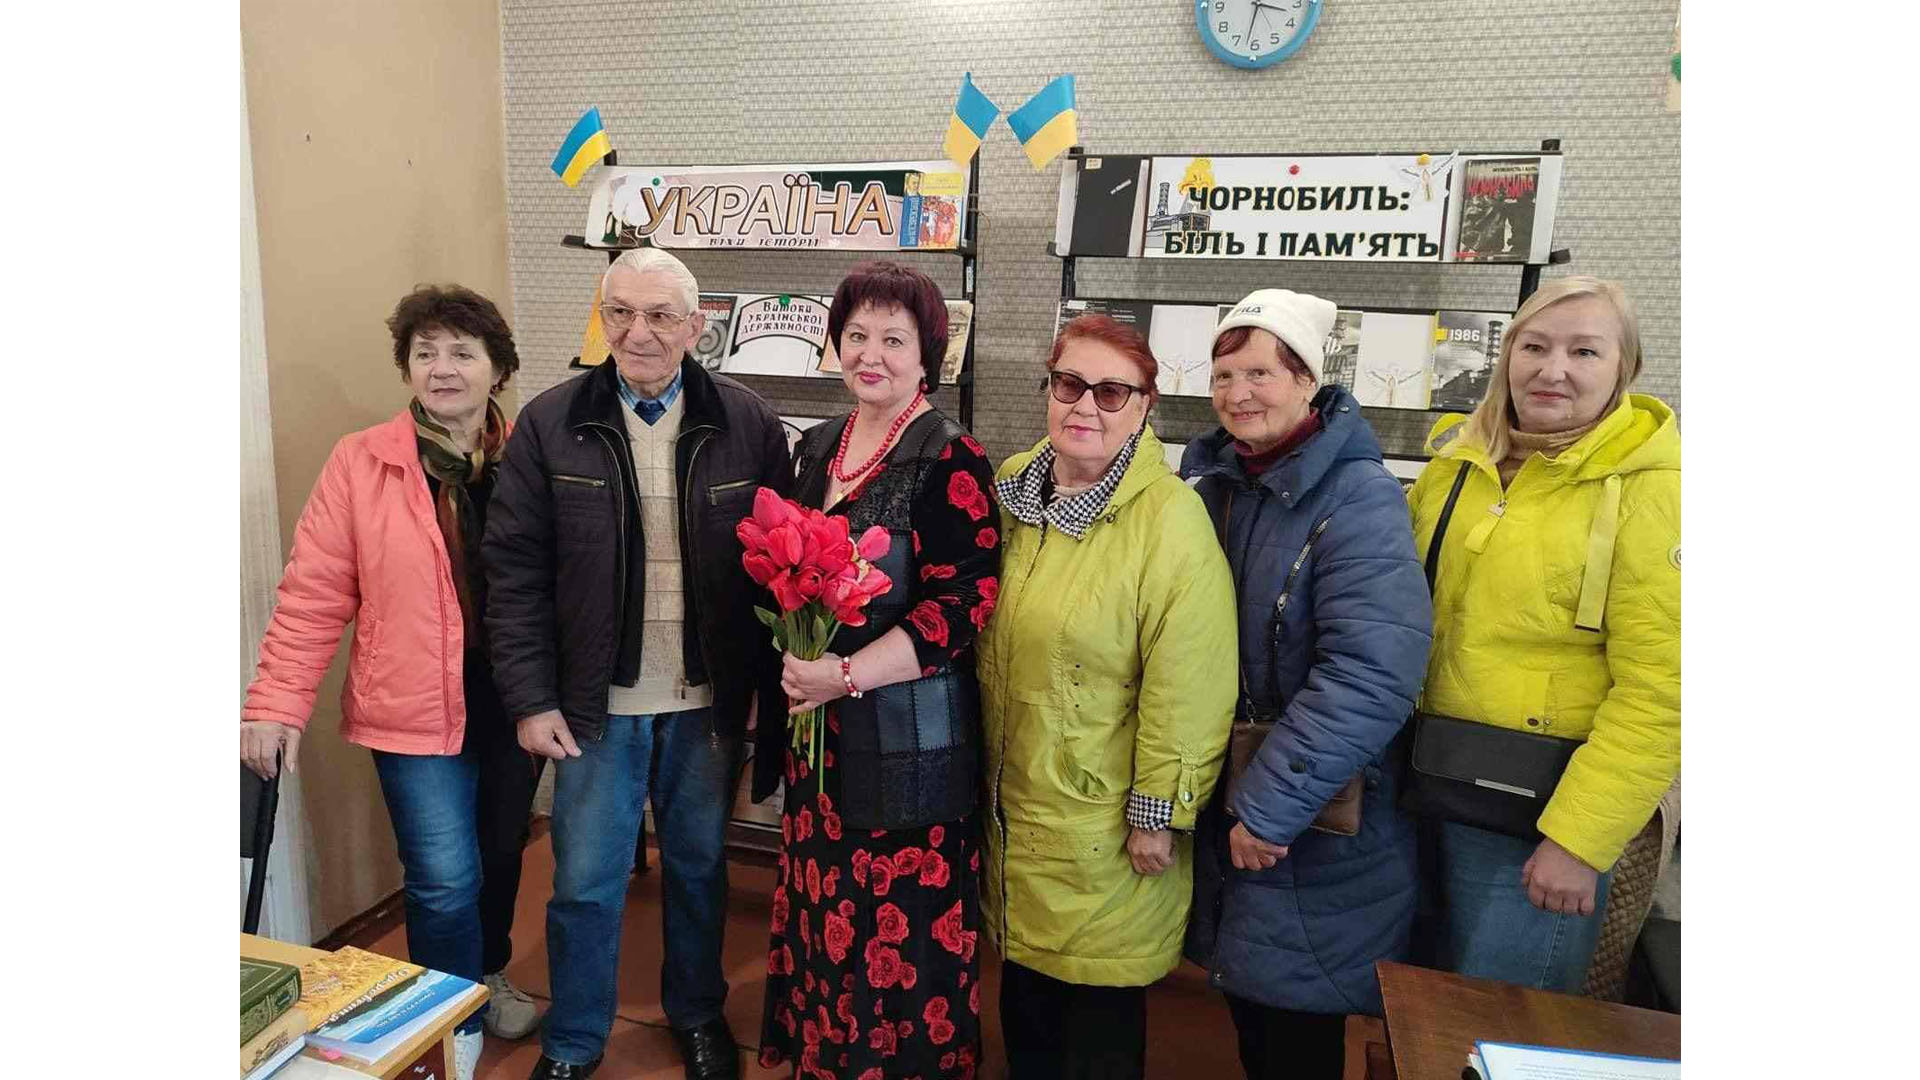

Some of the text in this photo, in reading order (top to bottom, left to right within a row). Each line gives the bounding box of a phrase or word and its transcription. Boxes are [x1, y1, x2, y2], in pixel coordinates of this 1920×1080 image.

[1215, 2, 1225, 13] 9
[1219, 21, 1229, 32] 8
[1286, 17, 1295, 28] 4
[1232, 35, 1241, 46] 7
[1270, 33, 1280, 44] 5
[1250, 40, 1260, 51] 6
[1188, 185, 1411, 212] ЧОРНОБИЛЬ:
[636, 173, 895, 236] УКРАЇНА
[1163, 231, 1246, 256] БІЛЬ
[1256, 232, 1268, 256] І
[744, 322, 825, 337] ДЕРЖАВНОСТІ
[1450, 328, 1480, 341] 1986
